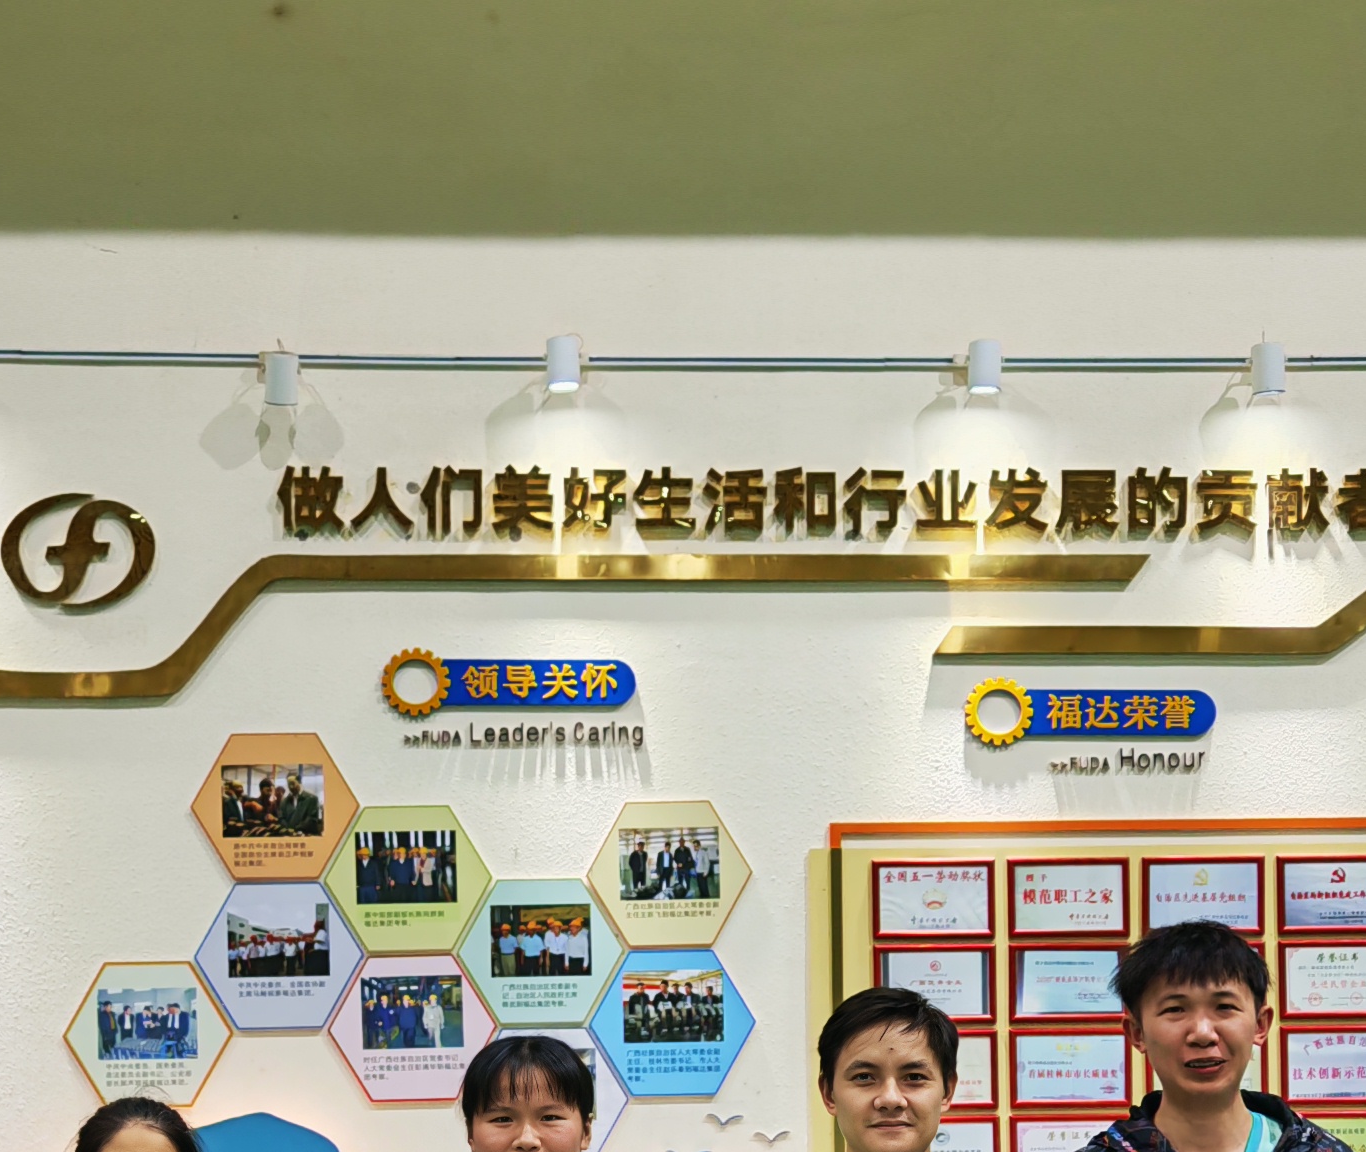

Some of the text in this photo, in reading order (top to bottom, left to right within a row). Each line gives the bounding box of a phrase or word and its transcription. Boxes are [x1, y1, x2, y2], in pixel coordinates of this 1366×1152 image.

[460, 663, 619, 699] 领导关怀
[1046, 693, 1196, 730] 福达荣誉
[421, 721, 644, 747] FUDA Leader's Caring
[1069, 747, 1206, 770] FUDA Honour
[883, 870, 986, 884] 全国五一劳动奖状
[1022, 888, 1114, 905] 模范职工之家
[1028, 1068, 1119, 1080] 首届桂林市市长质量奖
